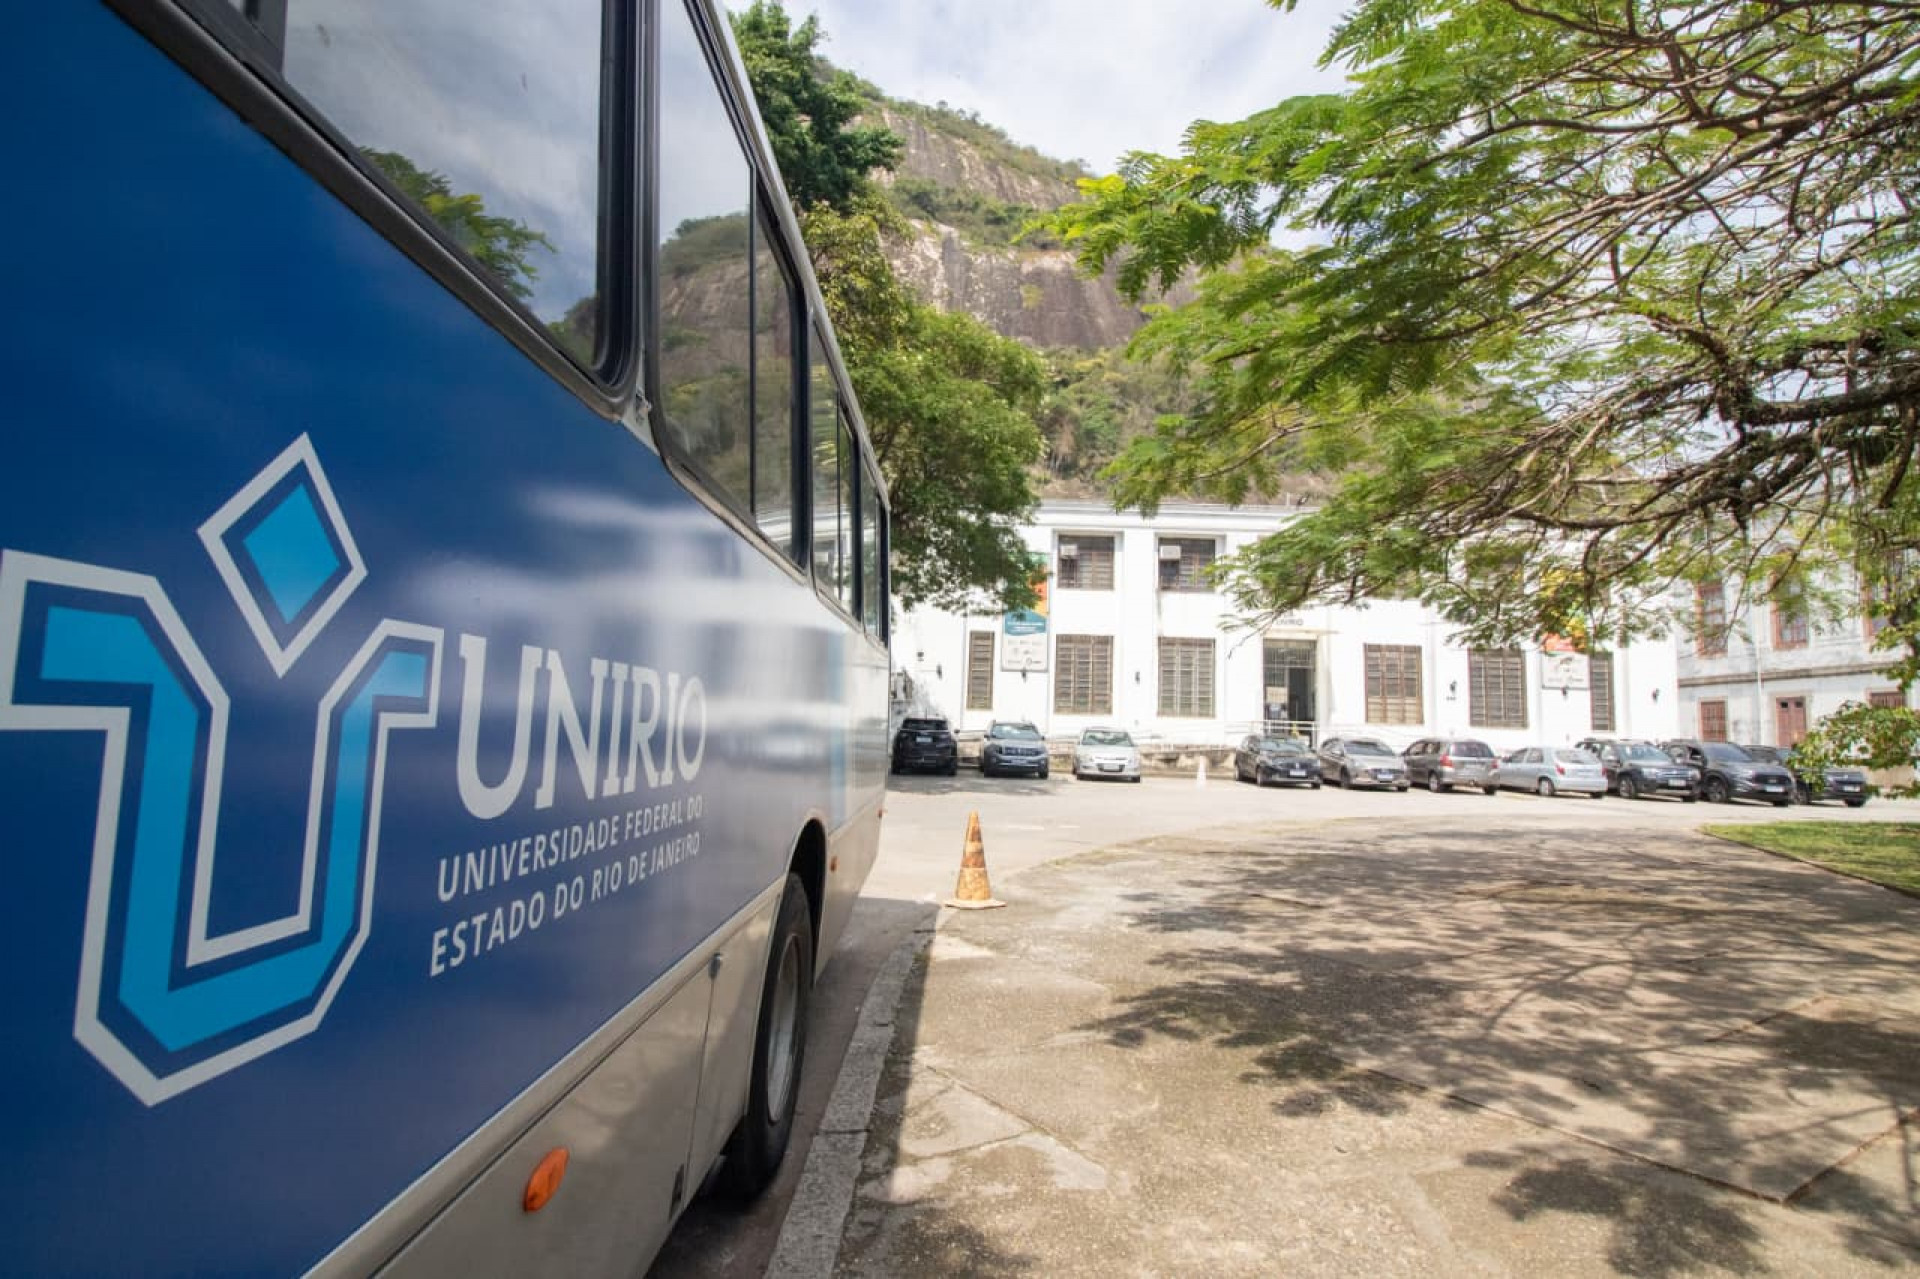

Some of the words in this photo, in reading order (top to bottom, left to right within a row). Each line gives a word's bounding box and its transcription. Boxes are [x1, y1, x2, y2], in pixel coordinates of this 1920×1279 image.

[457, 633, 707, 820] UNIRIO
[430, 891, 545, 977] ESTADO
[554, 876, 584, 919] DO
[591, 861, 622, 899] RIO
[628, 852, 646, 885] DE
[649, 831, 700, 874] JANEIRO
[438, 815, 619, 902] UNIVERSIDADE
[625, 803, 683, 842] FEDERAL
[686, 795, 703, 819] DO
